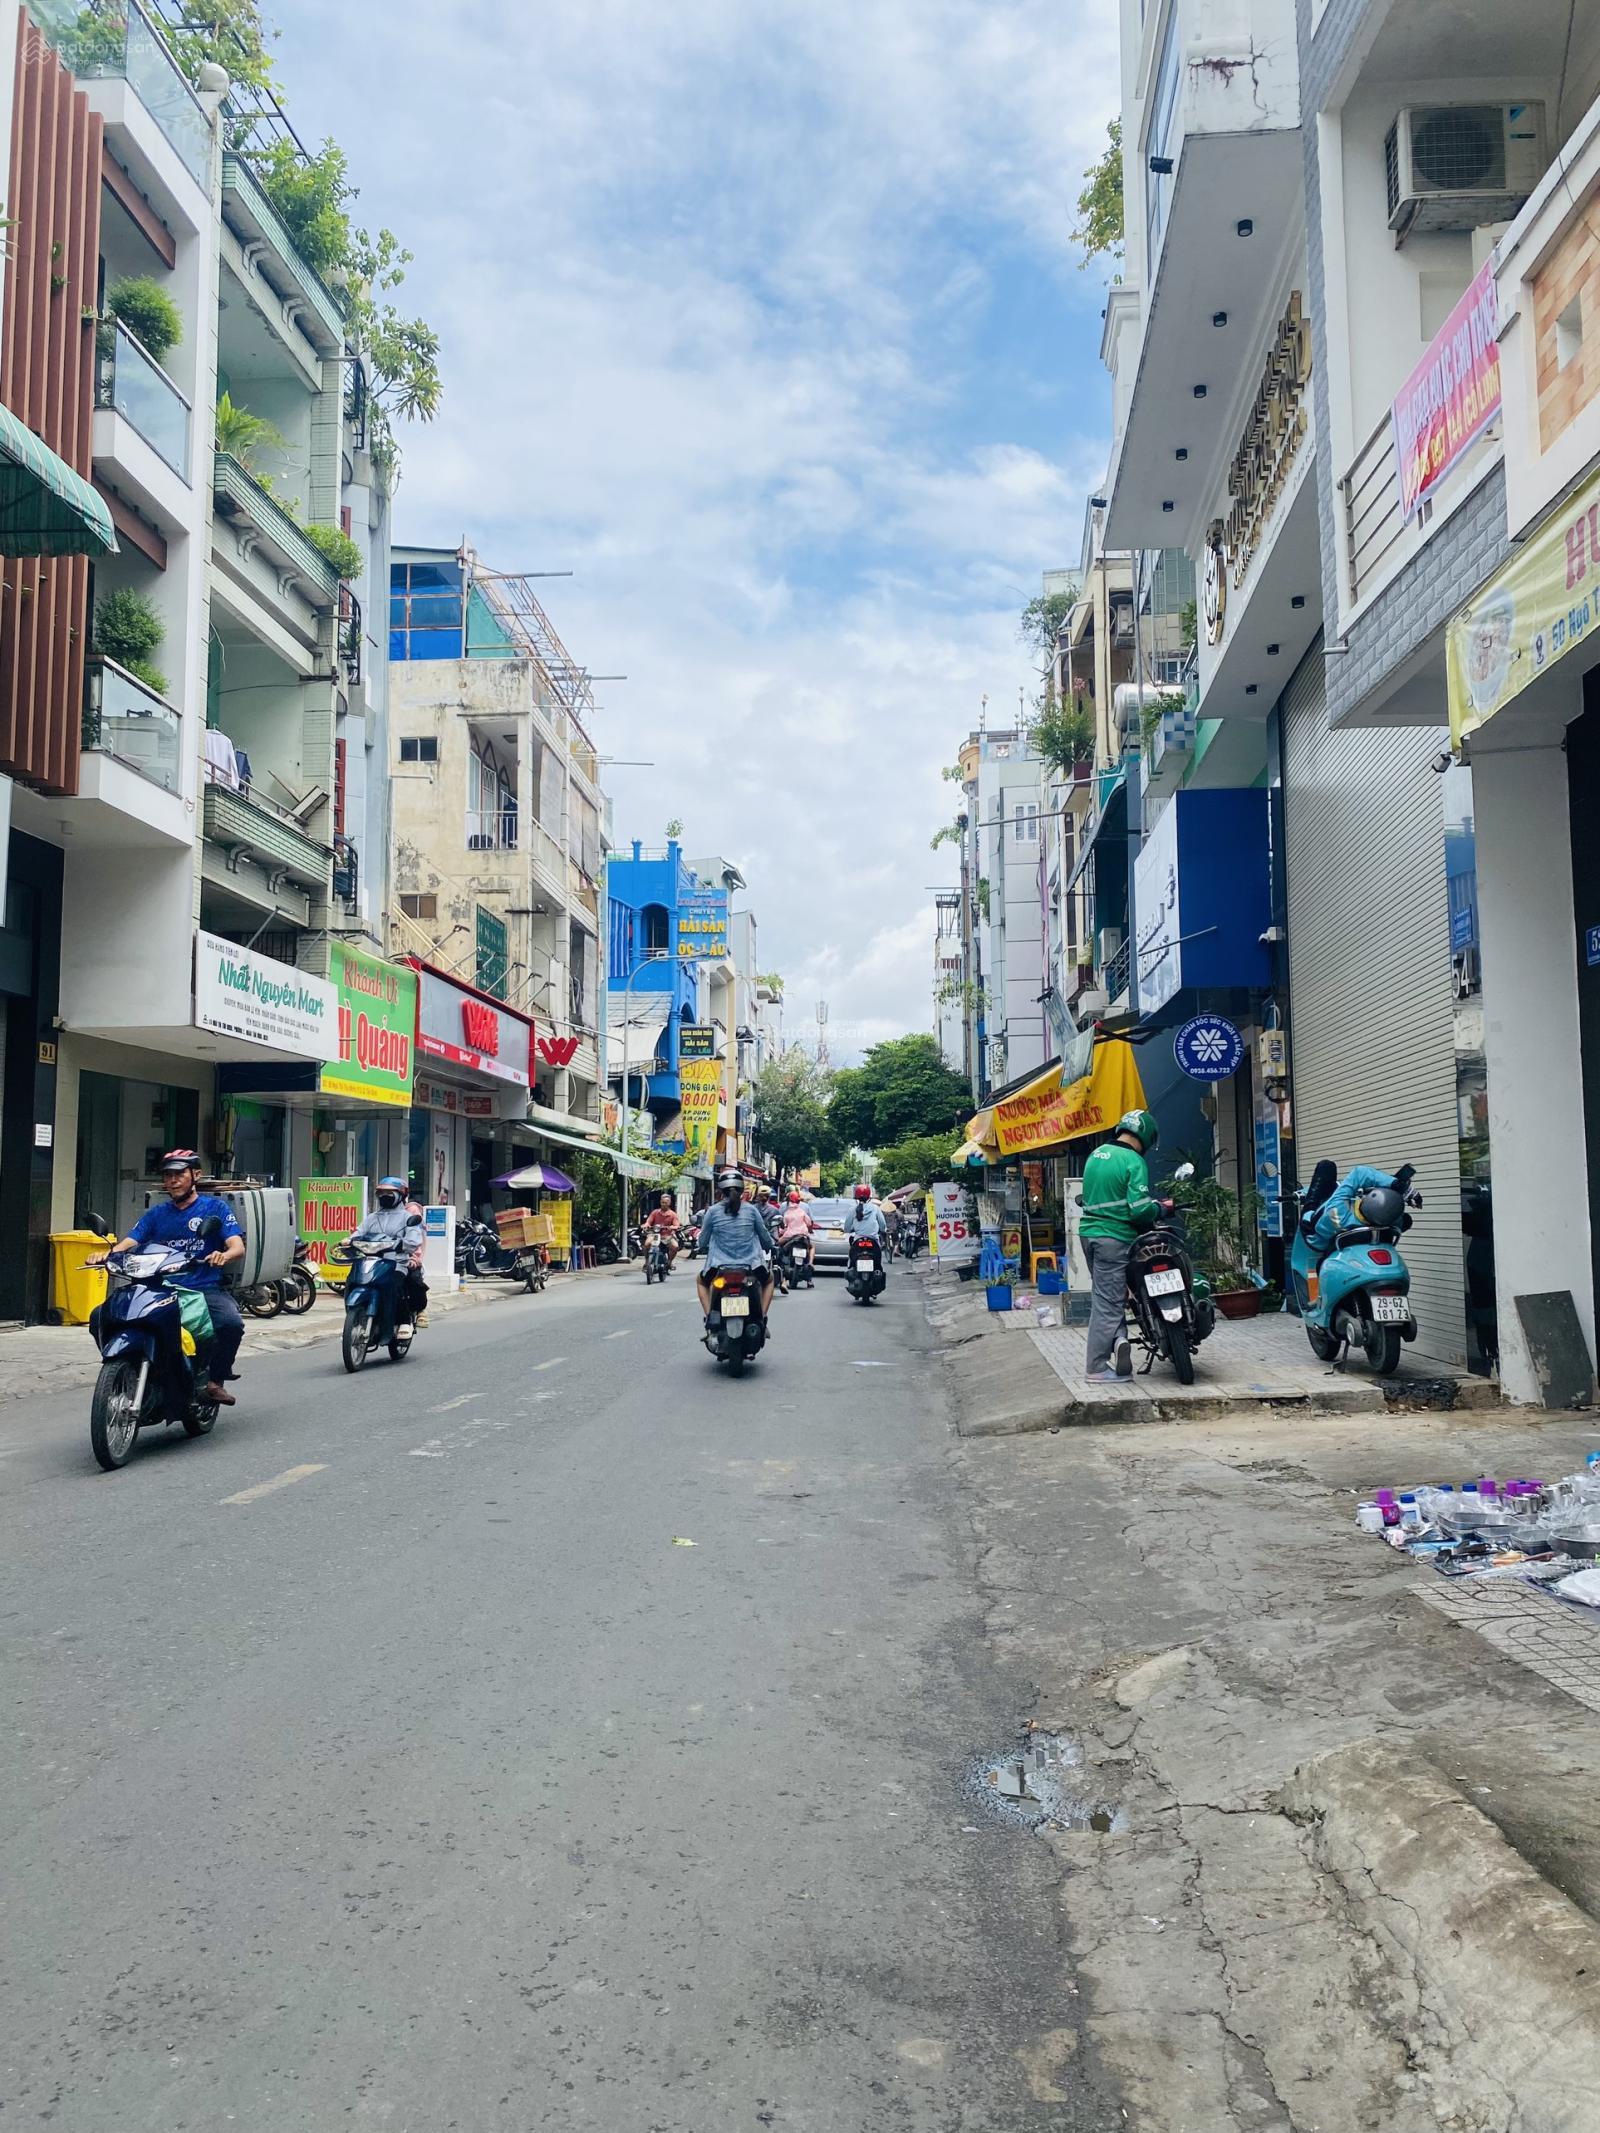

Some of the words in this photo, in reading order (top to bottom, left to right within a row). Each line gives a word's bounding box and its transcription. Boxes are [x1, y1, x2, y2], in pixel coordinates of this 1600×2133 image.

[218, 958, 251, 993] Nhất
[252, 970, 298, 1008] Nguyên
[298, 987, 326, 1018] Mart
[344, 959, 384, 1000] Khánh
[41, 1045, 53, 1058] 91
[357, 1011, 409, 1081] Quảng
[680, 1061, 717, 1080] BIA
[1002, 1115, 1063, 1147] NGUYÊN
[1064, 1100, 1103, 1131] CHẤT
[321, 1197, 358, 1236] Quảng
